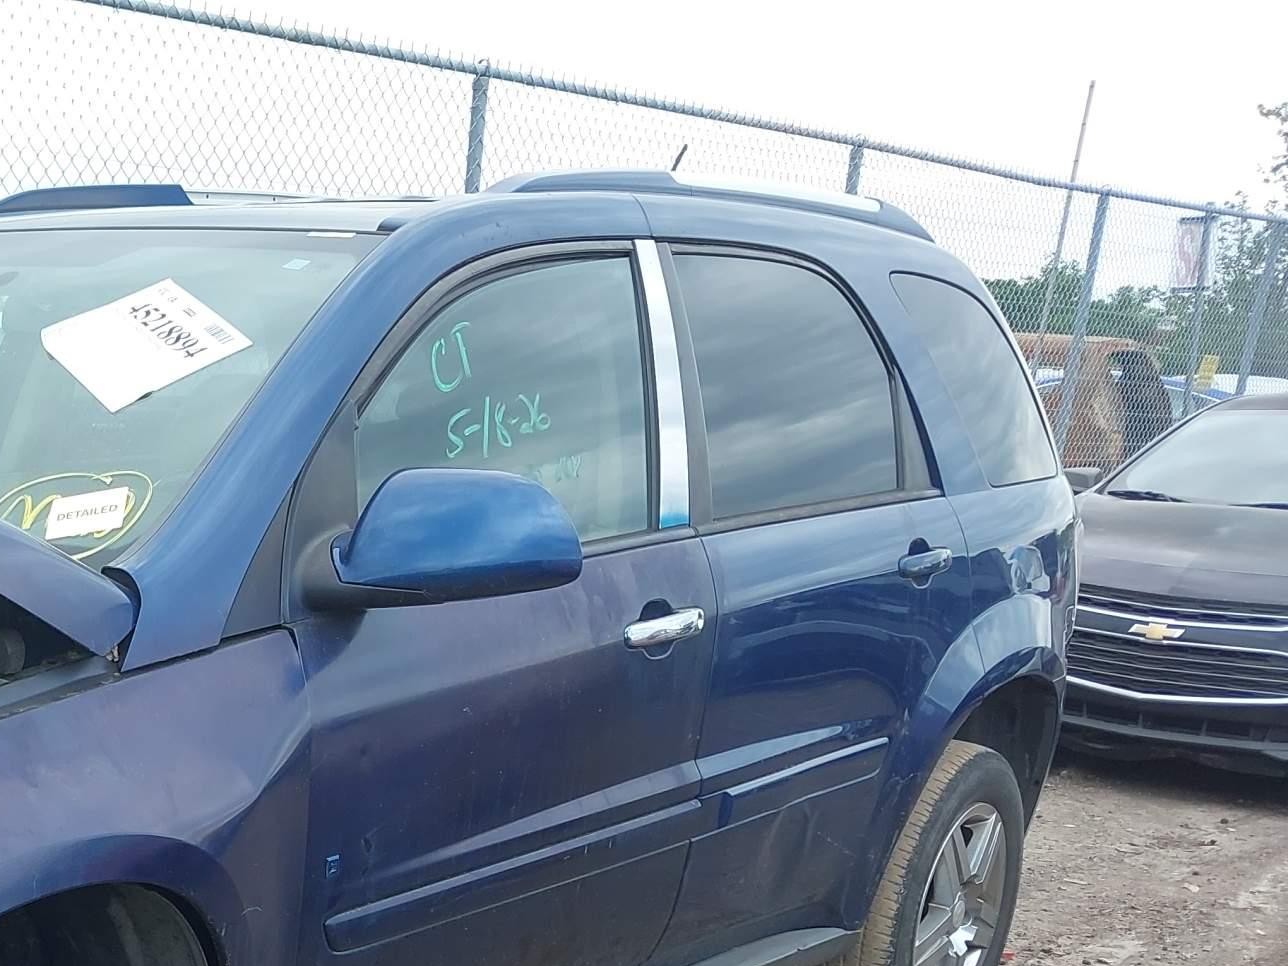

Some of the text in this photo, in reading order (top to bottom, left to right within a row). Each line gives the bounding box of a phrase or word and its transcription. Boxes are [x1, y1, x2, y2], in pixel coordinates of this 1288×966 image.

[128, 303, 209, 359] 45218894
[446, 393, 552, 459] 5-18-26
[56, 504, 118, 521] DETAILED
